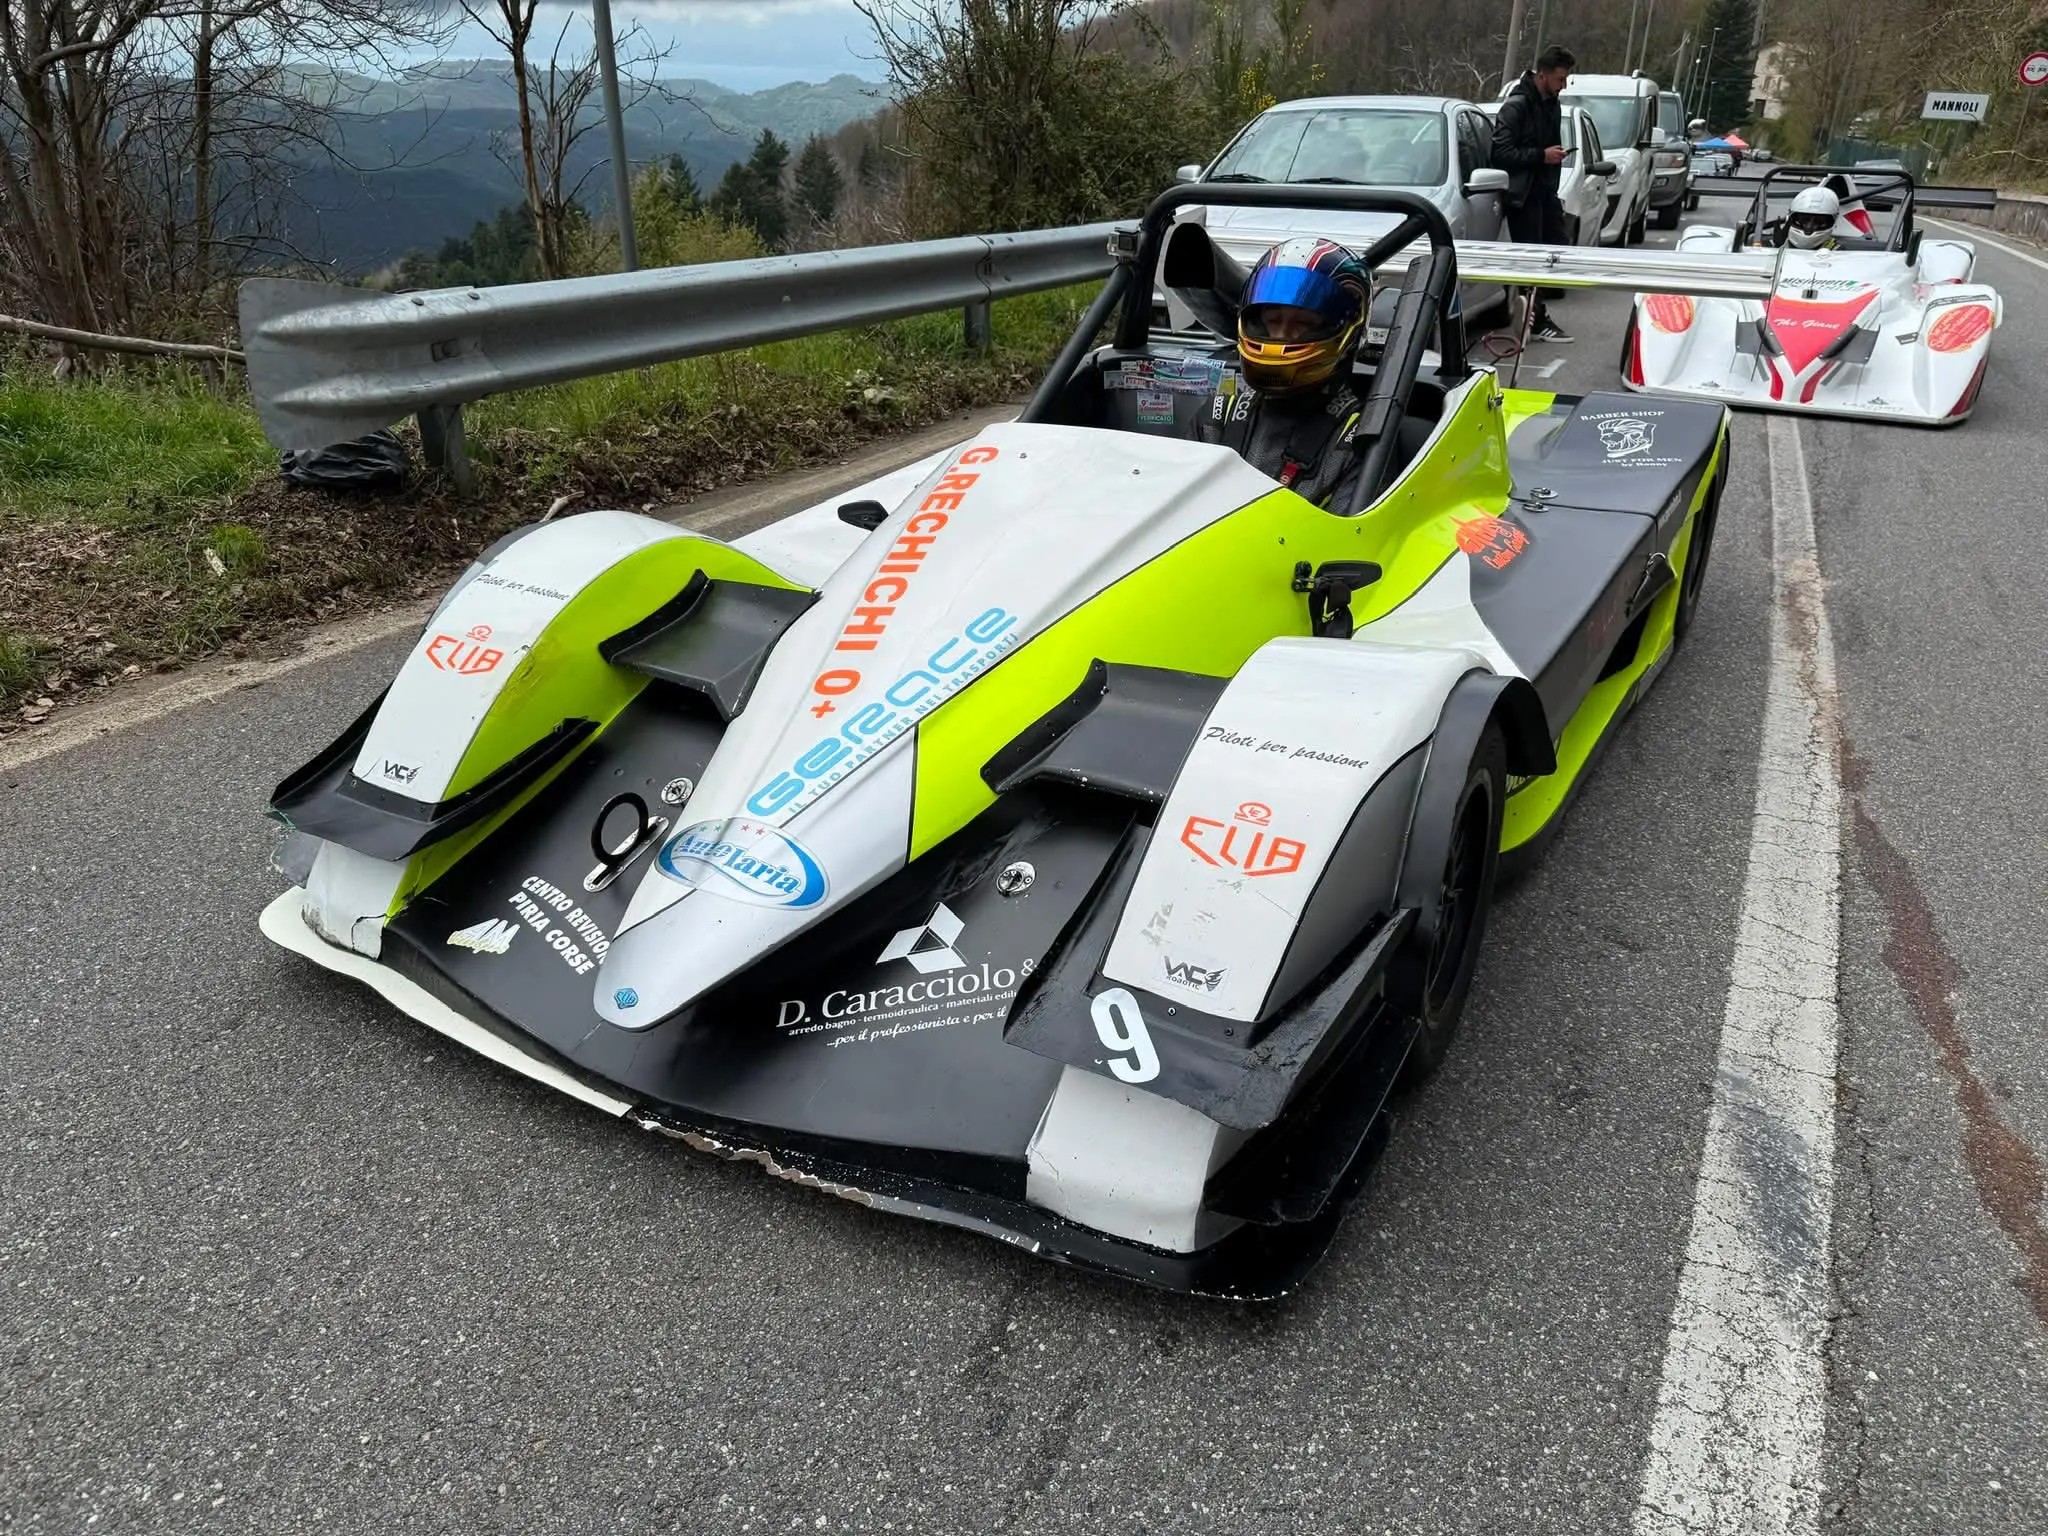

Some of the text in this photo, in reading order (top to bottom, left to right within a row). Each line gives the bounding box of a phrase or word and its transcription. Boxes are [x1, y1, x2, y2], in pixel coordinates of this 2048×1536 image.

[1932, 100, 1979, 113] MANNOLI
[1580, 412, 1629, 421] BARBER
[833, 446, 999, 652] G.RECHICHI
[808, 771, 841, 797] TUO
[846, 717, 914, 769] PARTNER
[914, 693, 938, 715] NEI
[942, 631, 1018, 693] TRASPORTI
[1203, 726, 1369, 769] Piloti per passione
[521, 876, 574, 912] CENTRO
[508, 891, 551, 933] PIRIA
[545, 929, 595, 975] CORSE
[776, 1000, 811, 1028] D.
[821, 963, 1016, 1020] Caracciolo
[788, 1023, 824, 1036] arredo
[825, 1017, 856, 1032] bagno
[863, 1002, 939, 1024] termoidraulica
[946, 992, 994, 1009] materiali
[869, 1013, 961, 1045] professionista
[972, 1010, 995, 1027] per
[997, 1005, 1008, 1019] il
[1091, 988, 1161, 1084] 9
